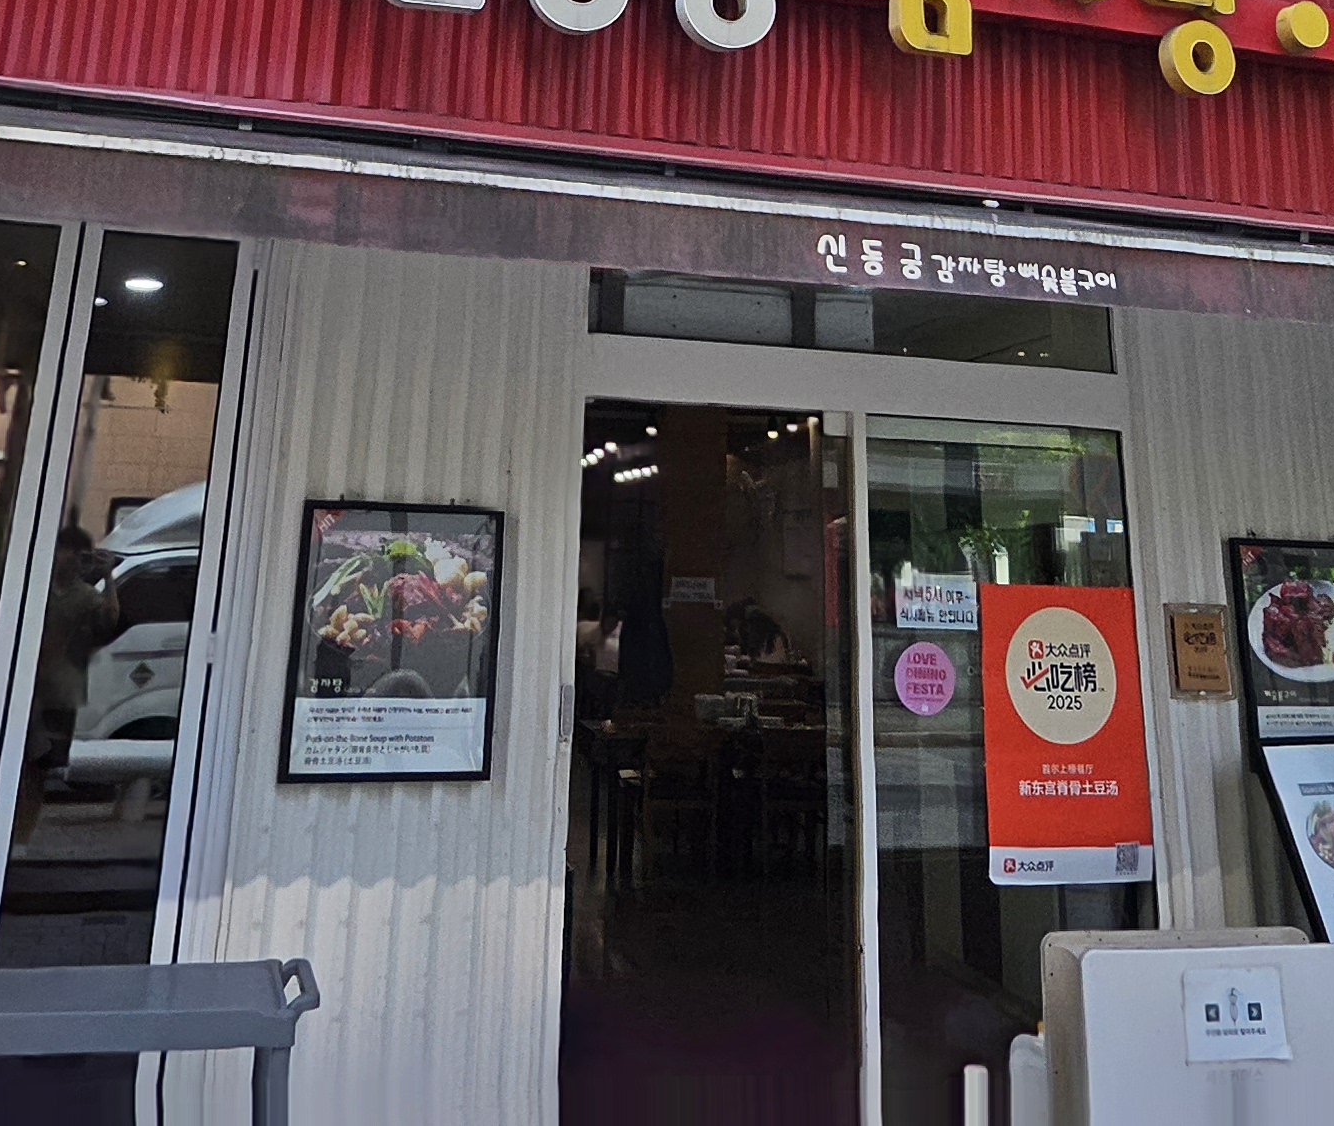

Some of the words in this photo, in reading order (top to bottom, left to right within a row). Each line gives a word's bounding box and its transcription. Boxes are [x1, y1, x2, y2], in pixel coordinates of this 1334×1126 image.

[317, 513, 335, 533] HIT
[1045, 643, 1092, 659] 大众点评
[906, 652, 937, 666] LOVE
[906, 667, 947, 681] DINING
[1020, 660, 1097, 694] 必吃榜
[906, 683, 945, 696] FESTA
[1046, 694, 1083, 711] 2025
[1017, 858, 1054, 873] 大众点评
